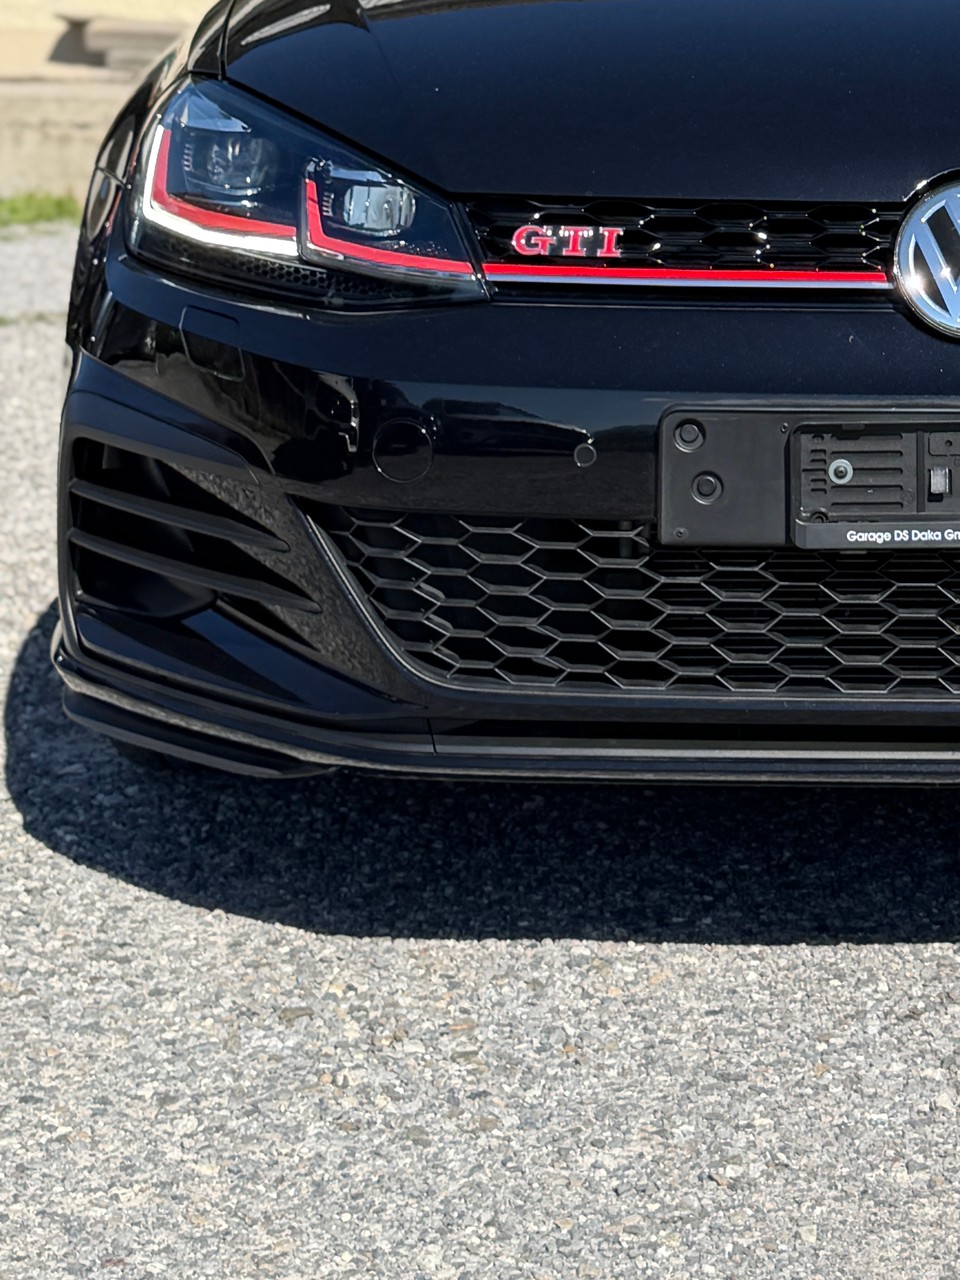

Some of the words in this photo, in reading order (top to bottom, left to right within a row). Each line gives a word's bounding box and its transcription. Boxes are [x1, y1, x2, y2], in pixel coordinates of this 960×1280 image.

[512, 225, 624, 257] GTI
[846, 530, 892, 544] Garage
[894, 530, 909, 541] DS
[911, 529, 942, 541] Daka
